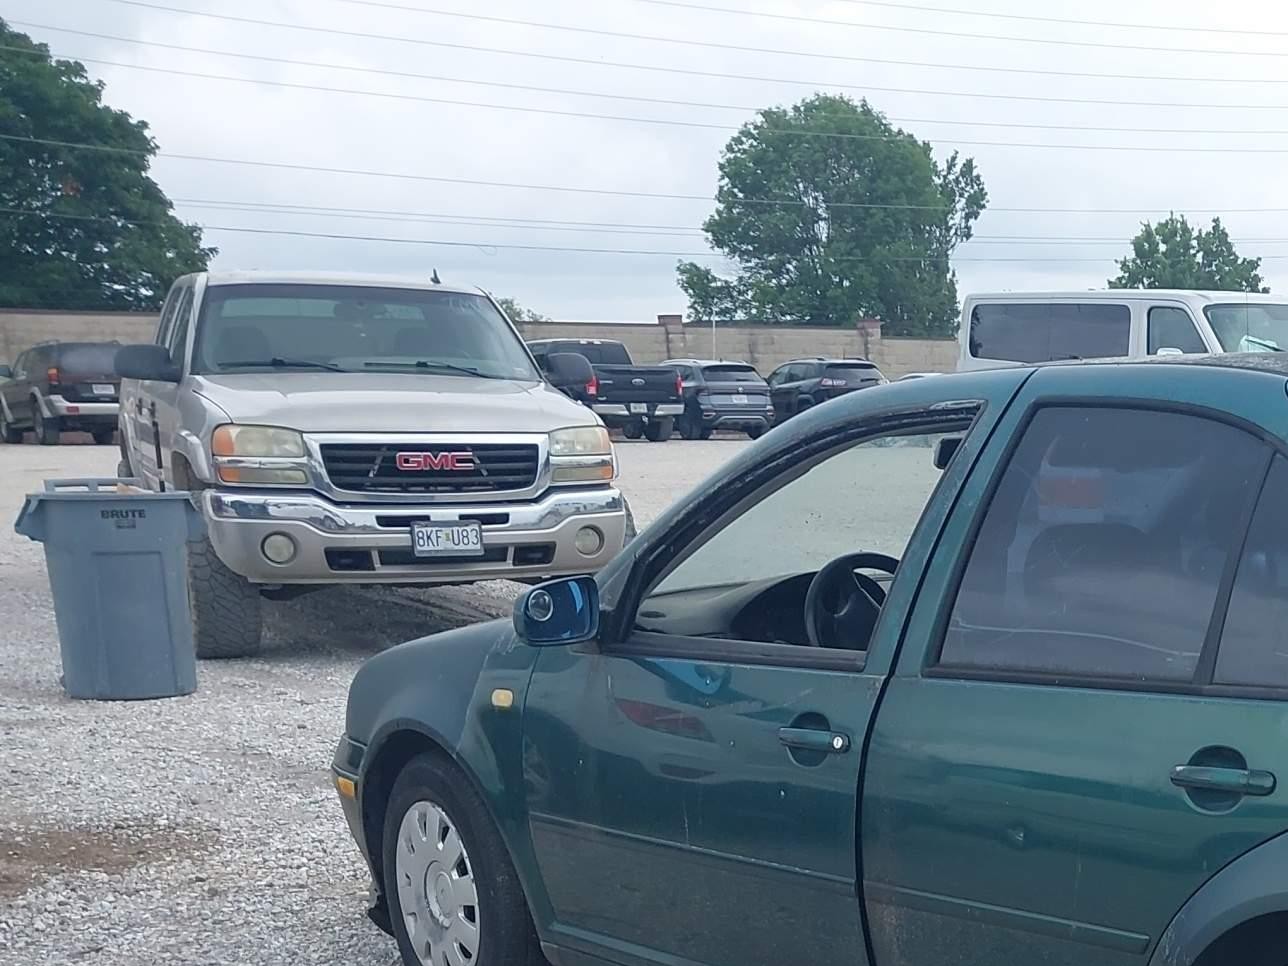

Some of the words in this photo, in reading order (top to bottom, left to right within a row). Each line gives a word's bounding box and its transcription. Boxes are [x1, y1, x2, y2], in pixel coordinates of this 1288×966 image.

[396, 452, 475, 470] GMC
[100, 509, 146, 519] BRUTE
[416, 529, 442, 548] 8KF
[451, 528, 480, 546] U83
